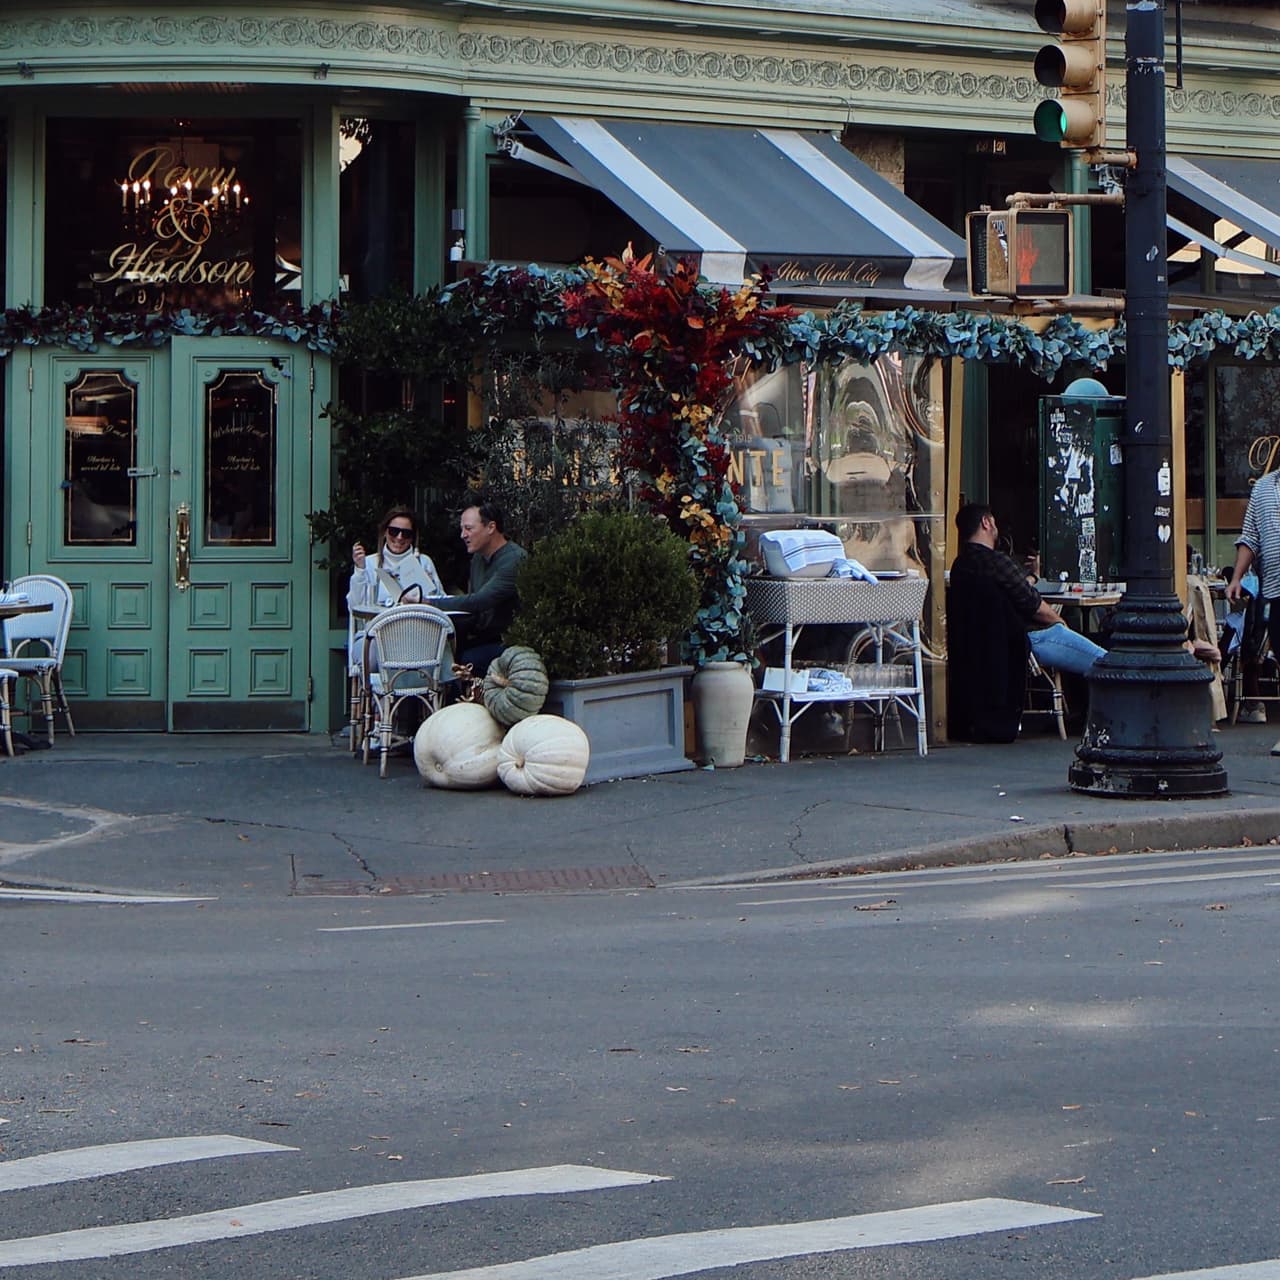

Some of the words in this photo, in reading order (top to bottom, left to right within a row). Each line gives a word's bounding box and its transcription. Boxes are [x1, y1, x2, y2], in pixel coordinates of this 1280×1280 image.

[114, 146, 237, 203] Perry
[154, 198, 213, 245] &
[91, 240, 256, 284] Hudson
[769, 261, 810, 282] New
[814, 261, 856, 287] York
[853, 262, 881, 288] City
